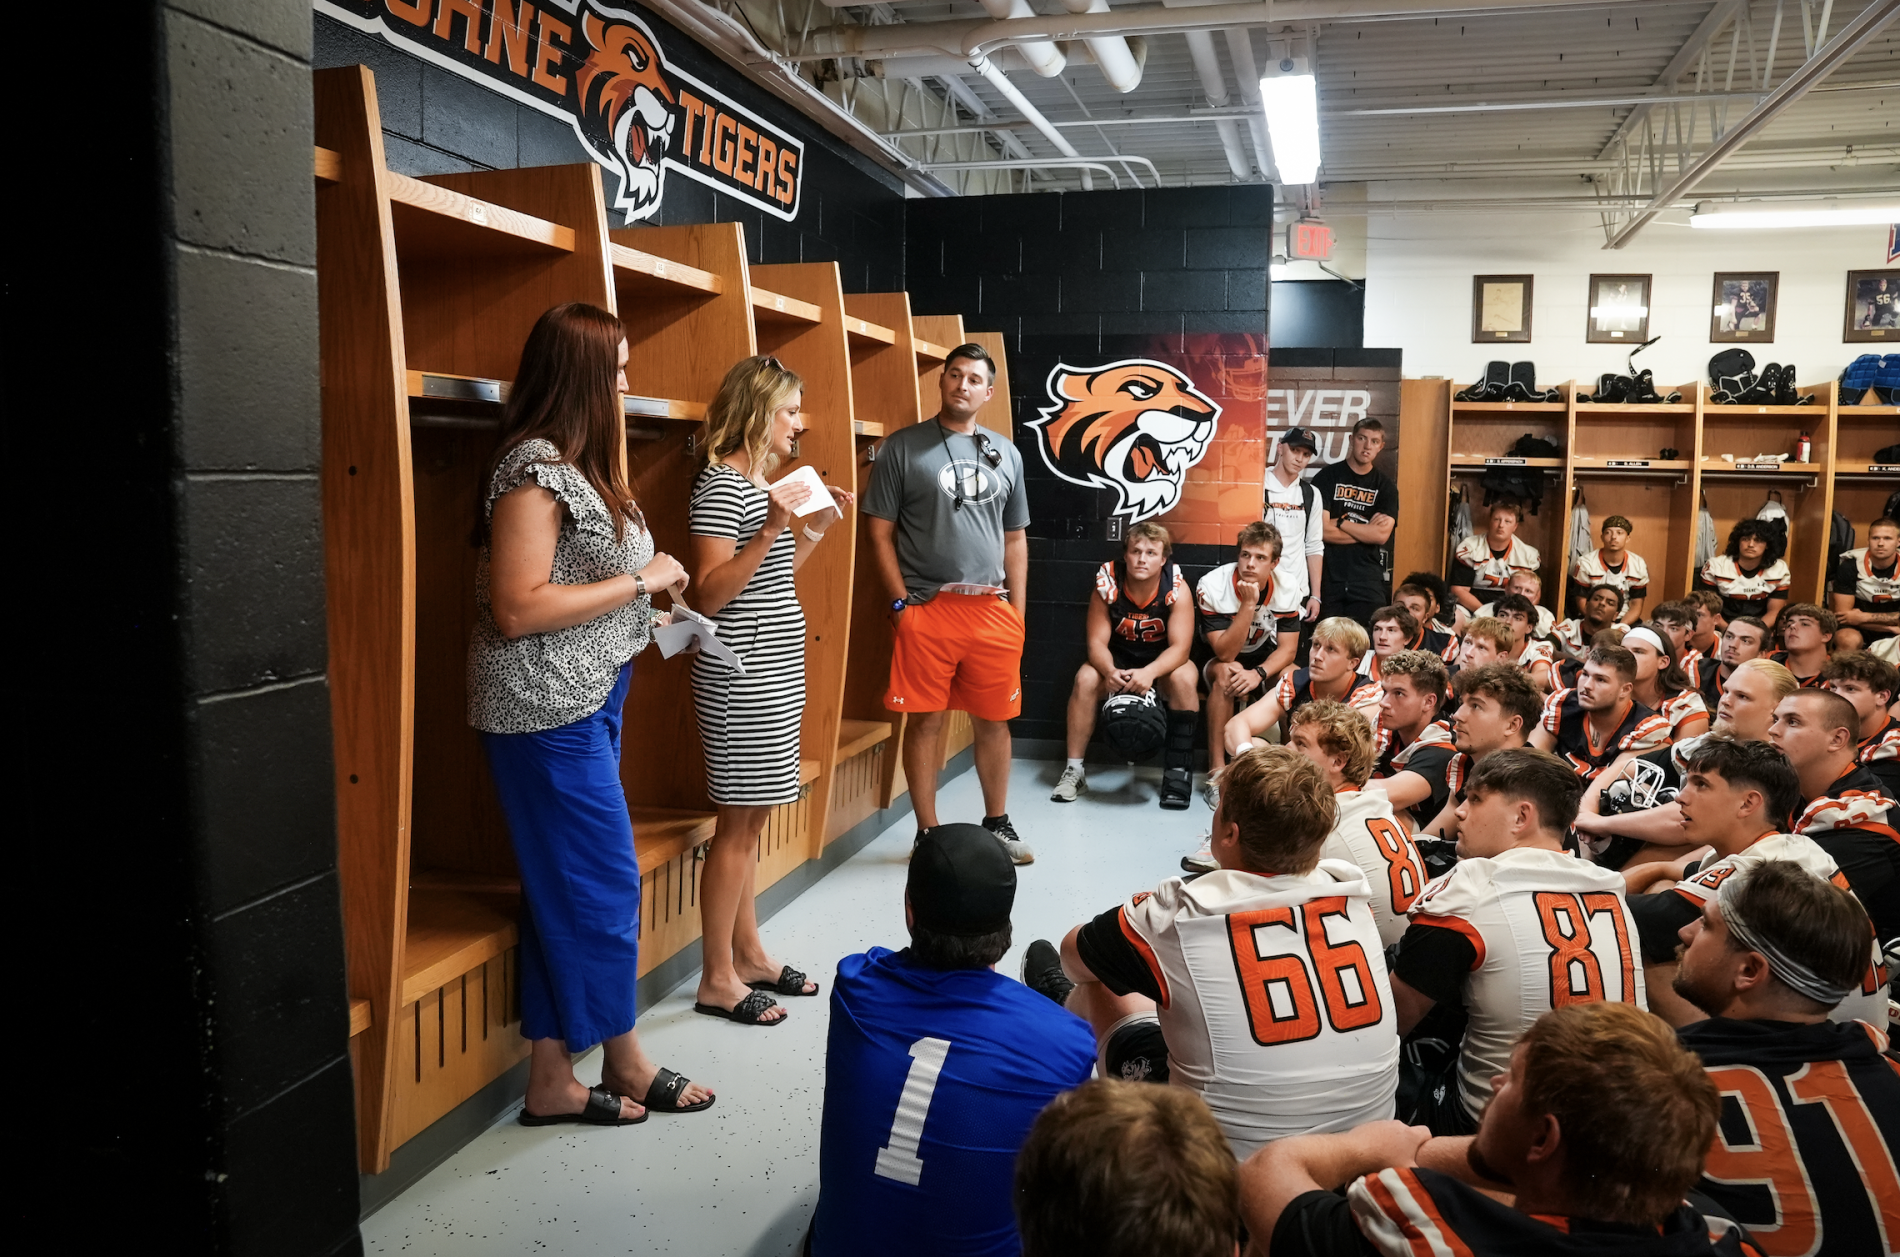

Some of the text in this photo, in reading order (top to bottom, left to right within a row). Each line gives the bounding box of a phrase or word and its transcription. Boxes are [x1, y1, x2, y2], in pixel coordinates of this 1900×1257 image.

[363, 0, 567, 96] ANE
[679, 89, 797, 205] TIGERS
[1298, 225, 1331, 257] EXIT
[1740, 291, 1751, 303] 35
[1876, 294, 1891, 305] 56
[1336, 486, 1376, 503] DOANE
[1115, 616, 1166, 642] 42
[1225, 896, 1383, 1047] 66
[1532, 891, 1637, 1010] 87
[874, 1036, 951, 1186] 1
[1701, 1060, 1900, 1257] 91
